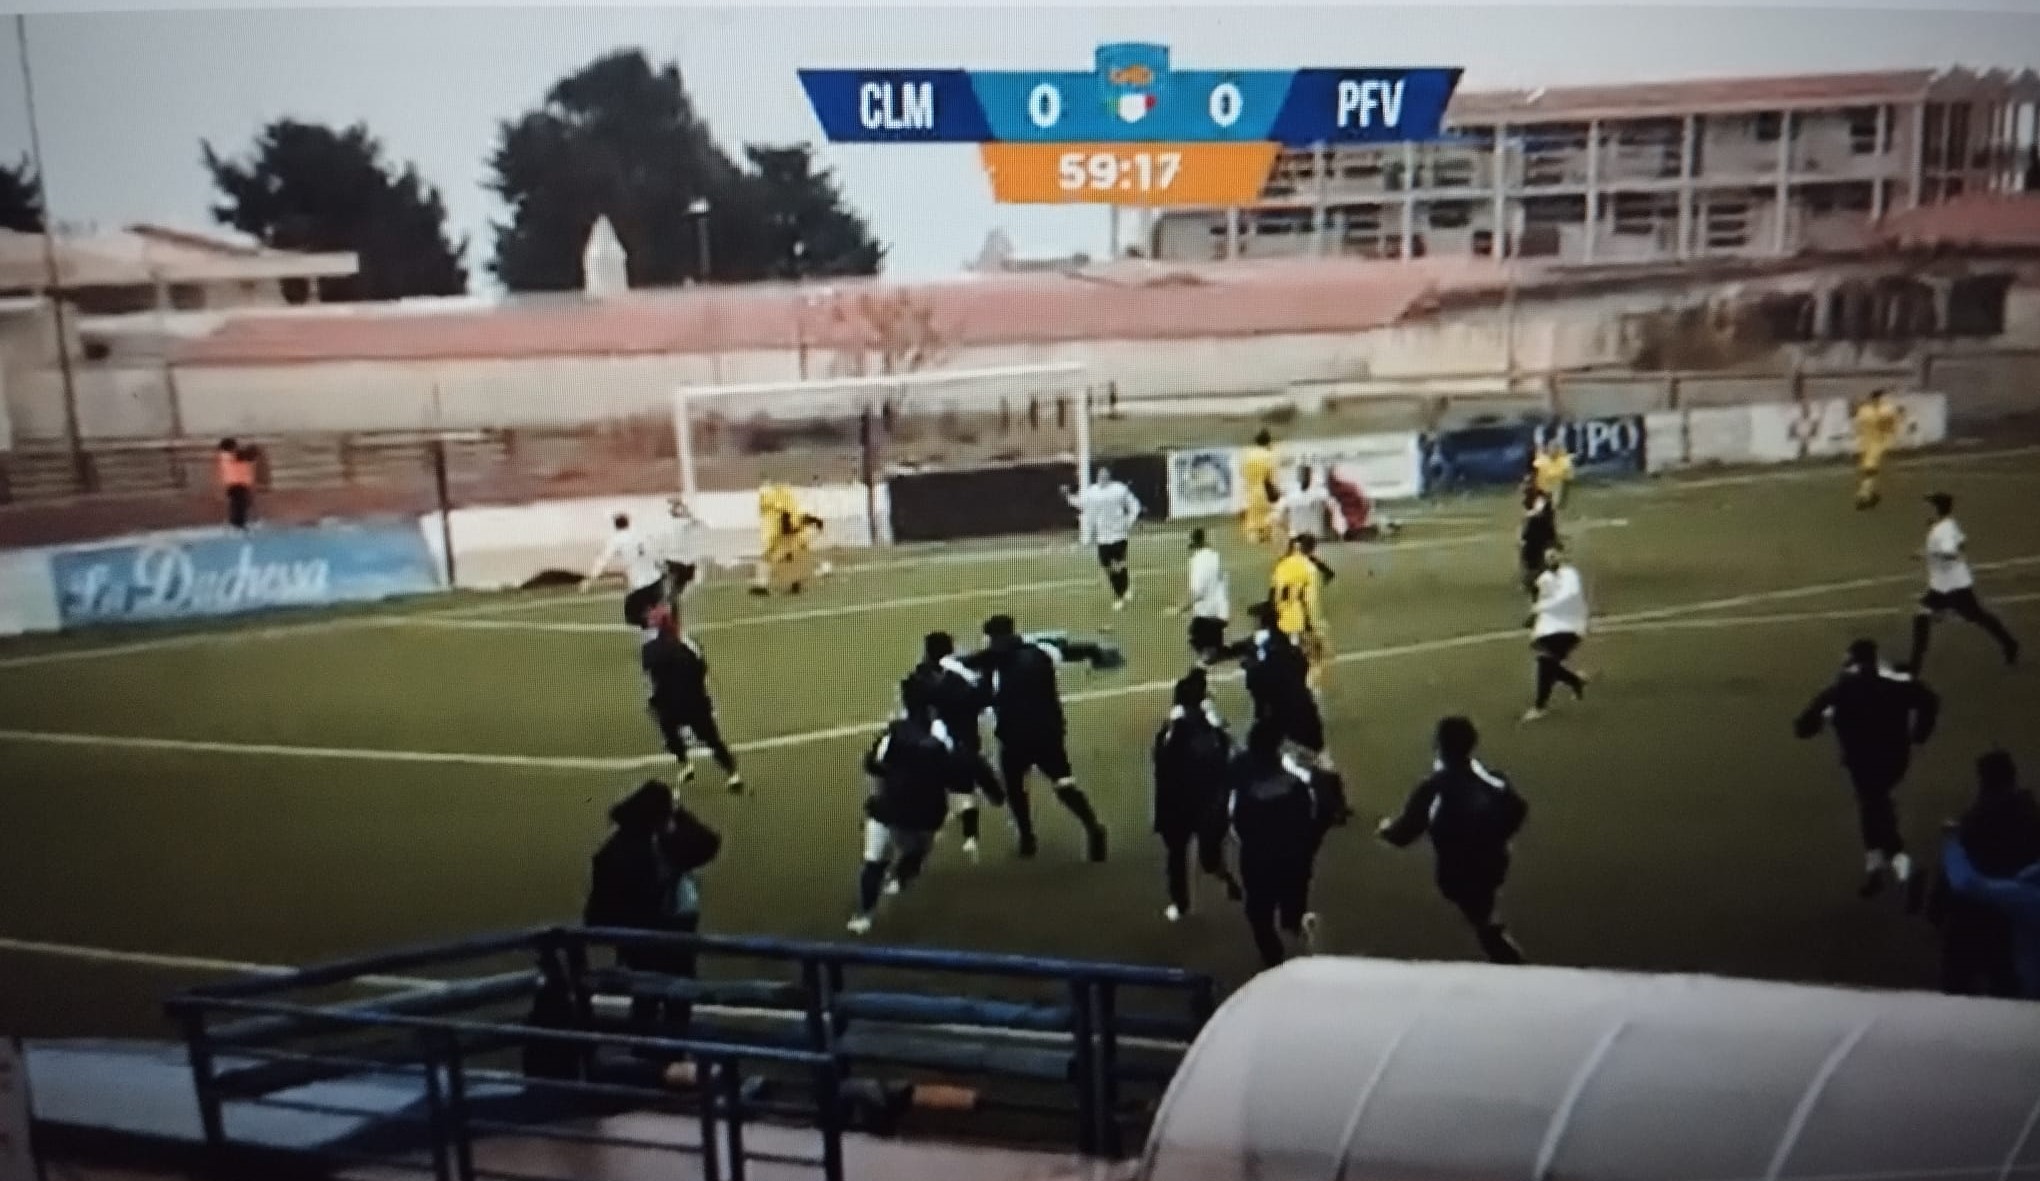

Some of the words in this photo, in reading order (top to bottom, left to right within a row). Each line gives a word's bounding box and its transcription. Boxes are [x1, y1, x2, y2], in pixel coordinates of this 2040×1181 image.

[861, 82, 934, 129] CLM
[1029, 84, 1060, 129] 0
[1210, 83, 1243, 127] 0
[1338, 80, 1405, 127] PFV
[1059, 152, 1181, 191] 59:17
